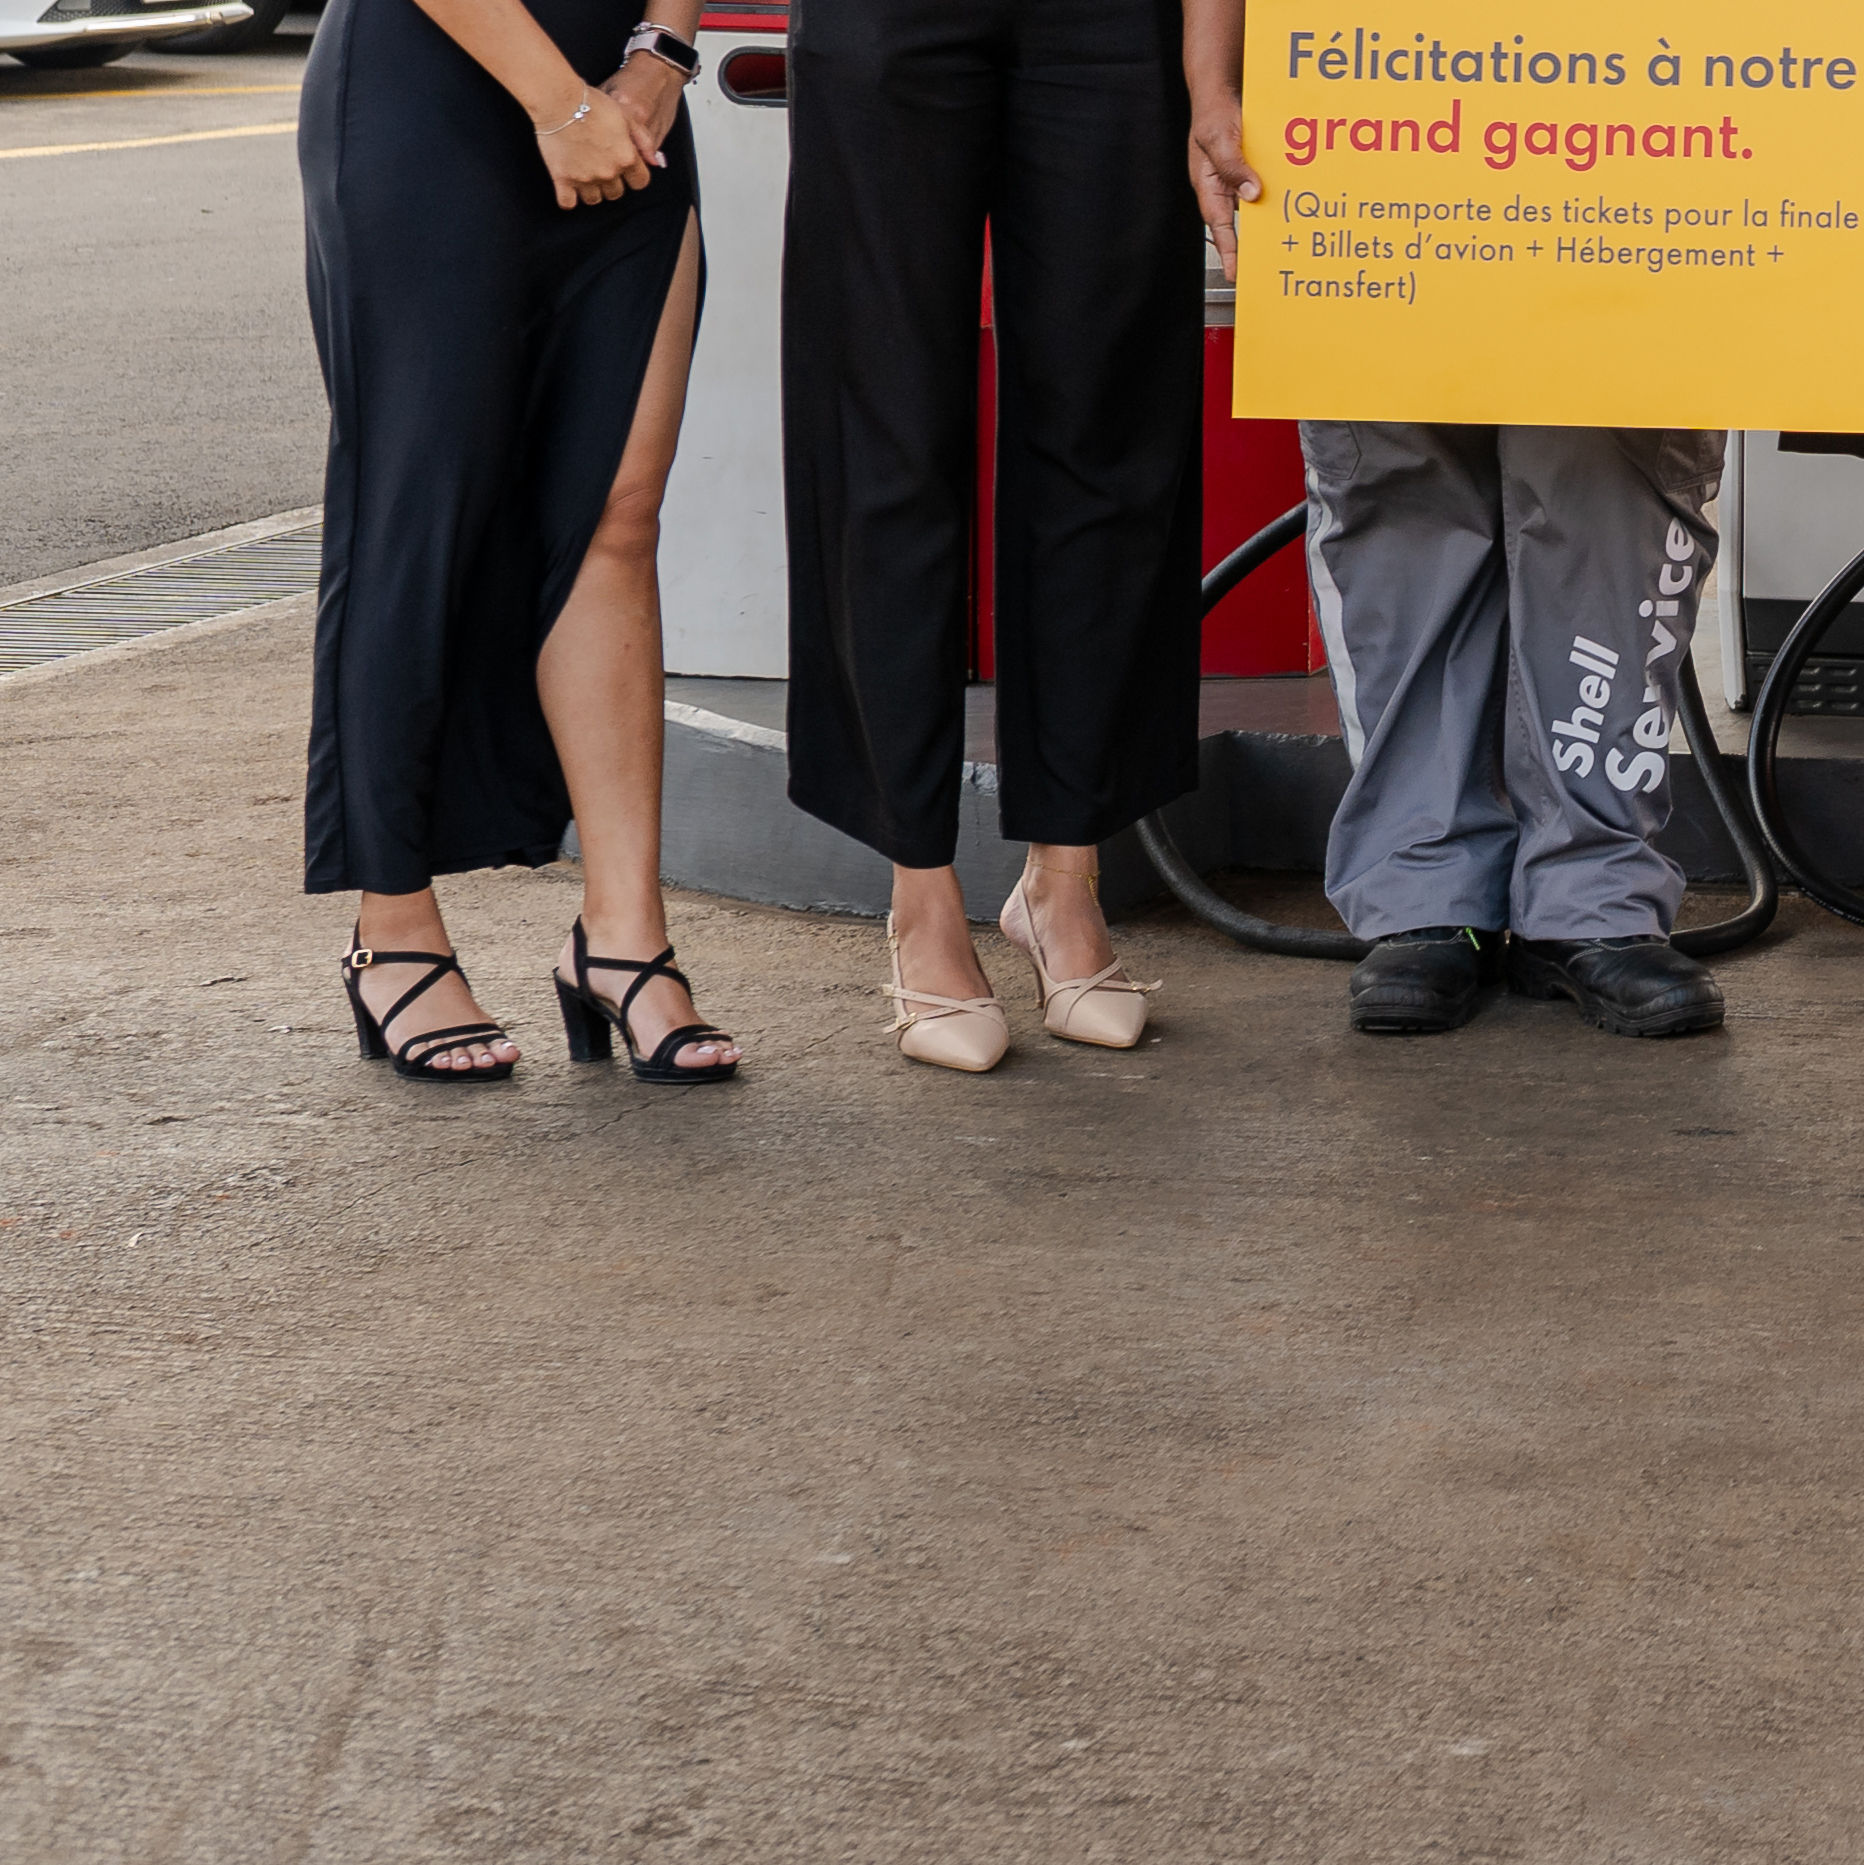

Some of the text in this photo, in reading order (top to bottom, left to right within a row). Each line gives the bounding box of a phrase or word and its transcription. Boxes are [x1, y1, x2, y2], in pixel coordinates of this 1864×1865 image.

[1288, 27, 1858, 90] Félicitations à notre
[1284, 98, 1753, 172] grand gagnant.
[1283, 189, 1860, 233] (Qui remporte des tickets pour la finale
[1281, 235, 1299, 253] +
[1311, 230, 1394, 260] Billets
[1526, 240, 1544, 258] +
[1556, 235, 1755, 272] Hébergement
[1766, 245, 1785, 263] +
[1279, 269, 1417, 305] Transfert)
[1604, 517, 1695, 794] Service
[1551, 635, 1620, 778] Shell
